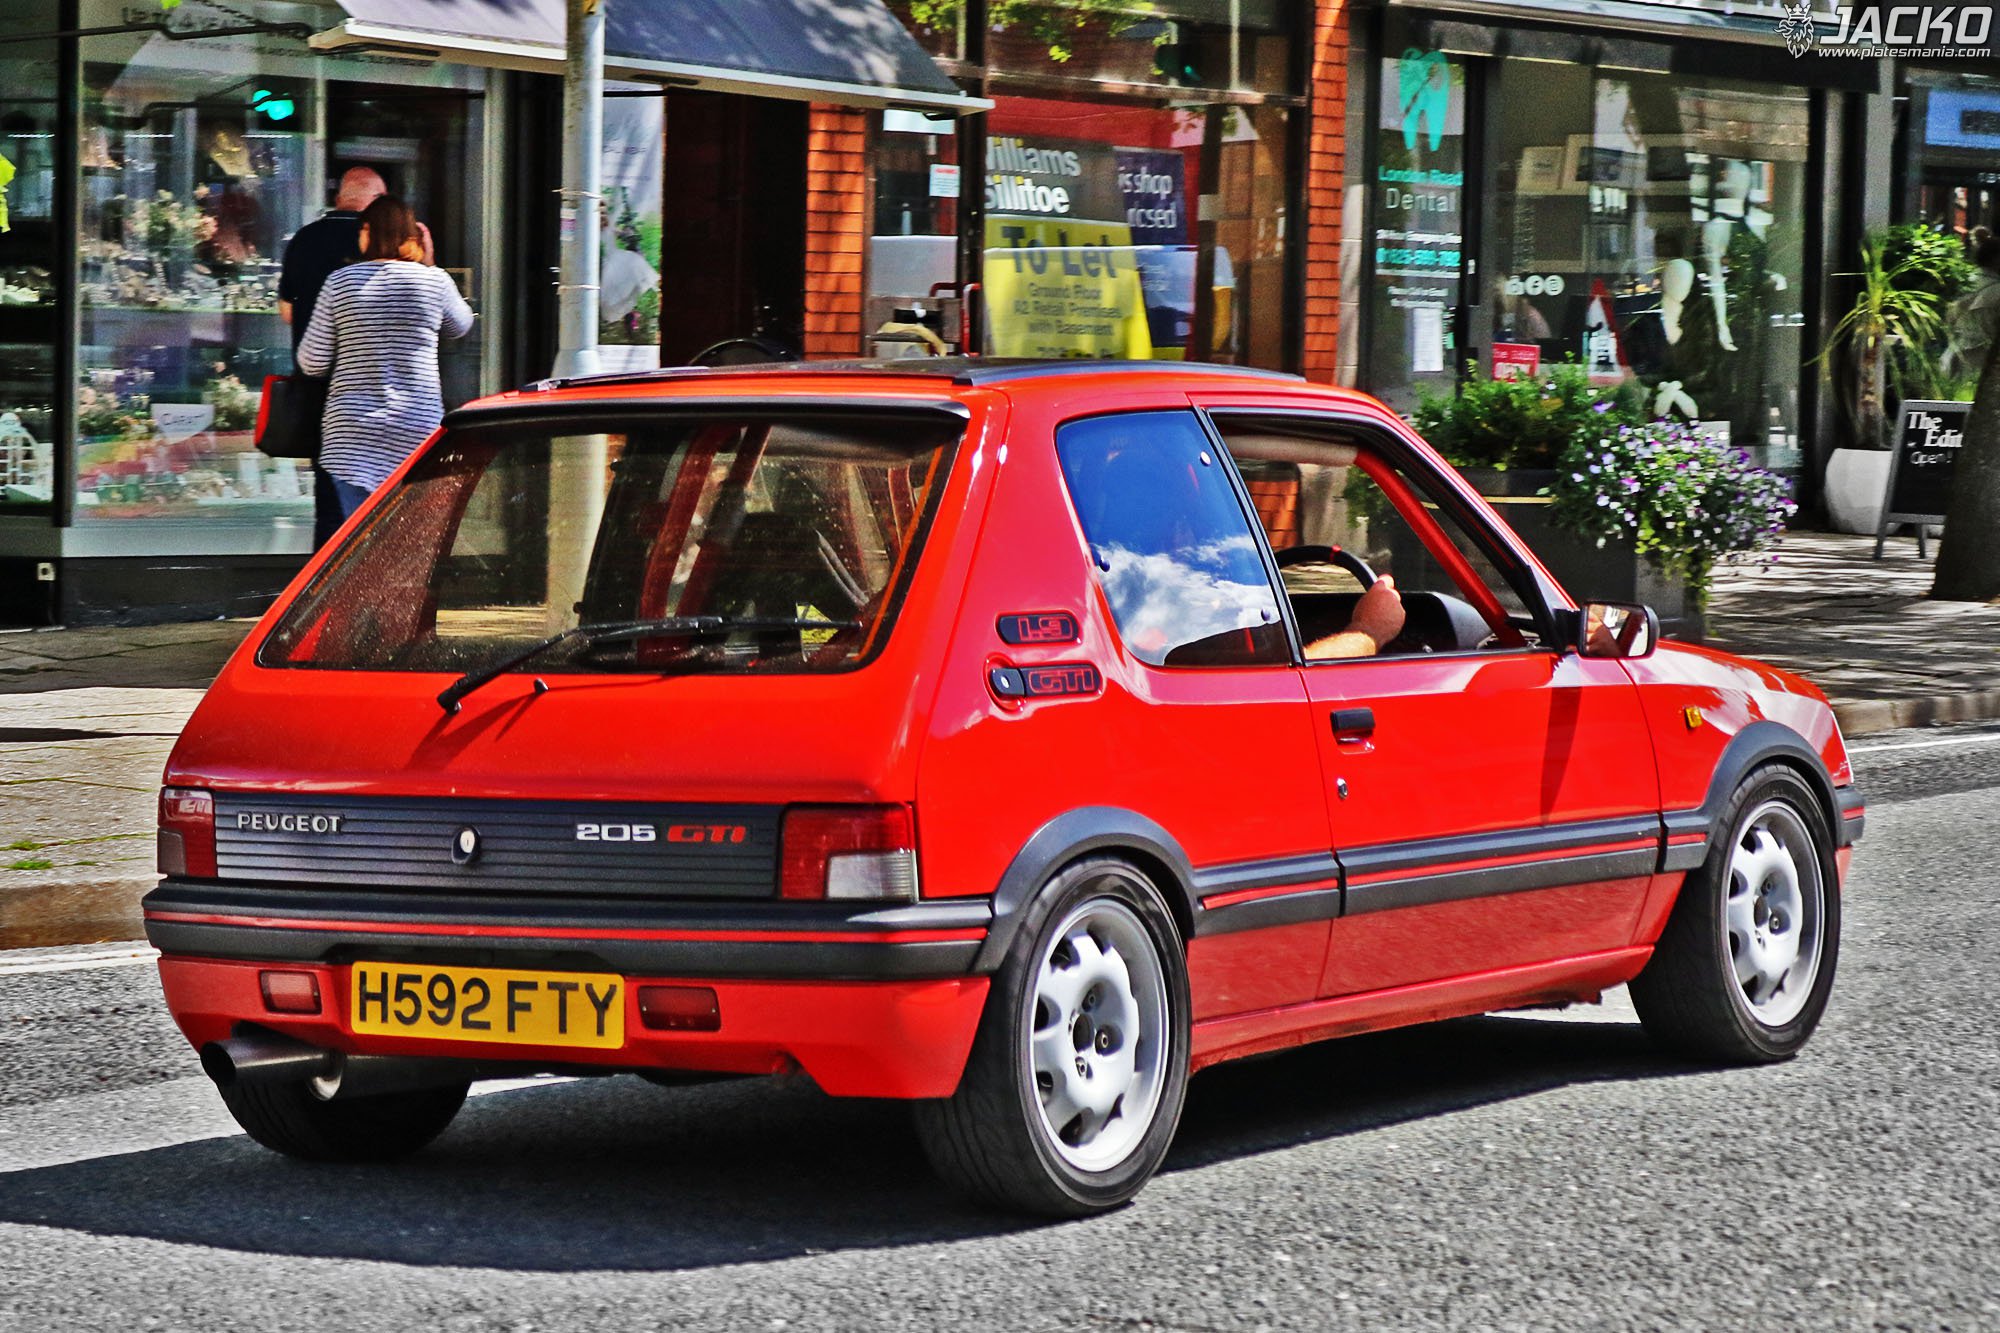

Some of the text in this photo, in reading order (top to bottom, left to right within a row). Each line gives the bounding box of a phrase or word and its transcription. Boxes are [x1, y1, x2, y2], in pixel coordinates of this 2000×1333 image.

[1134, 166, 1173, 200] shop
[1385, 187, 1457, 213] Dental
[1002, 226, 1118, 278] To Let
[1028, 282, 1071, 298] Ground
[1907, 411, 1943, 430] The
[1017, 616, 1073, 642] 1.9
[1028, 668, 1095, 694] GTI
[237, 812, 341, 833] PEUGEOT
[576, 823, 746, 843] 205 GTI
[359, 970, 618, 1038] H592 FTY
